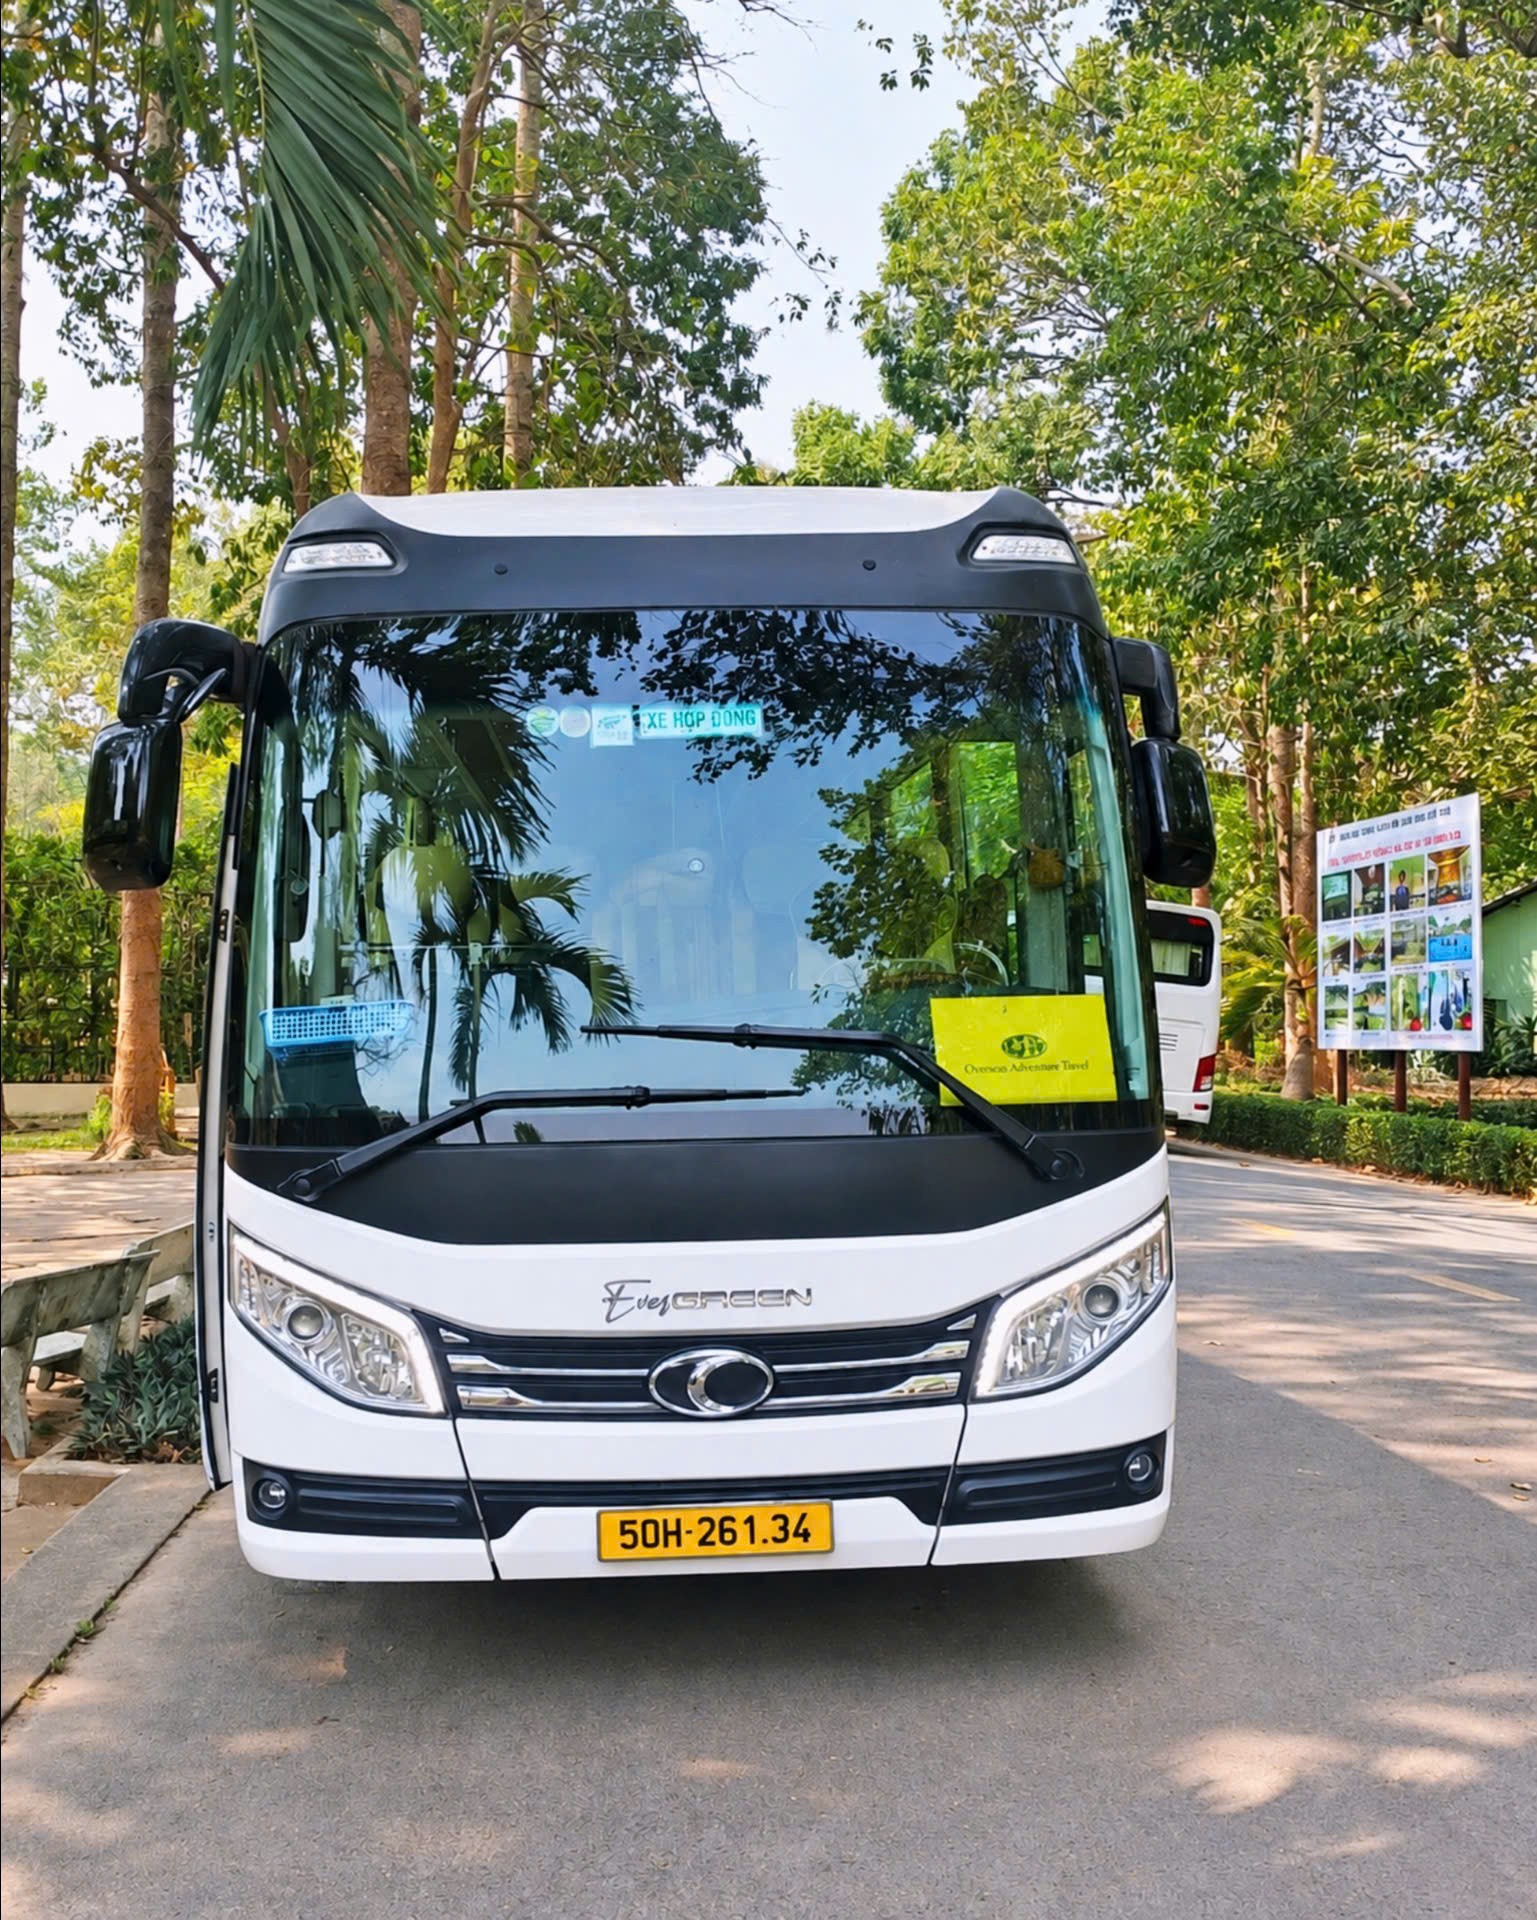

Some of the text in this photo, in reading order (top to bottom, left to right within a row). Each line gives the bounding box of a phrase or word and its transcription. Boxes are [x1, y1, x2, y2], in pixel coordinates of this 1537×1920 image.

[648, 711, 667, 729] XE
[1010, 1063, 1060, 1073] Adventure
[1062, 1060, 1089, 1071] Travel
[619, 1513, 811, 1550] 50H-261.34
